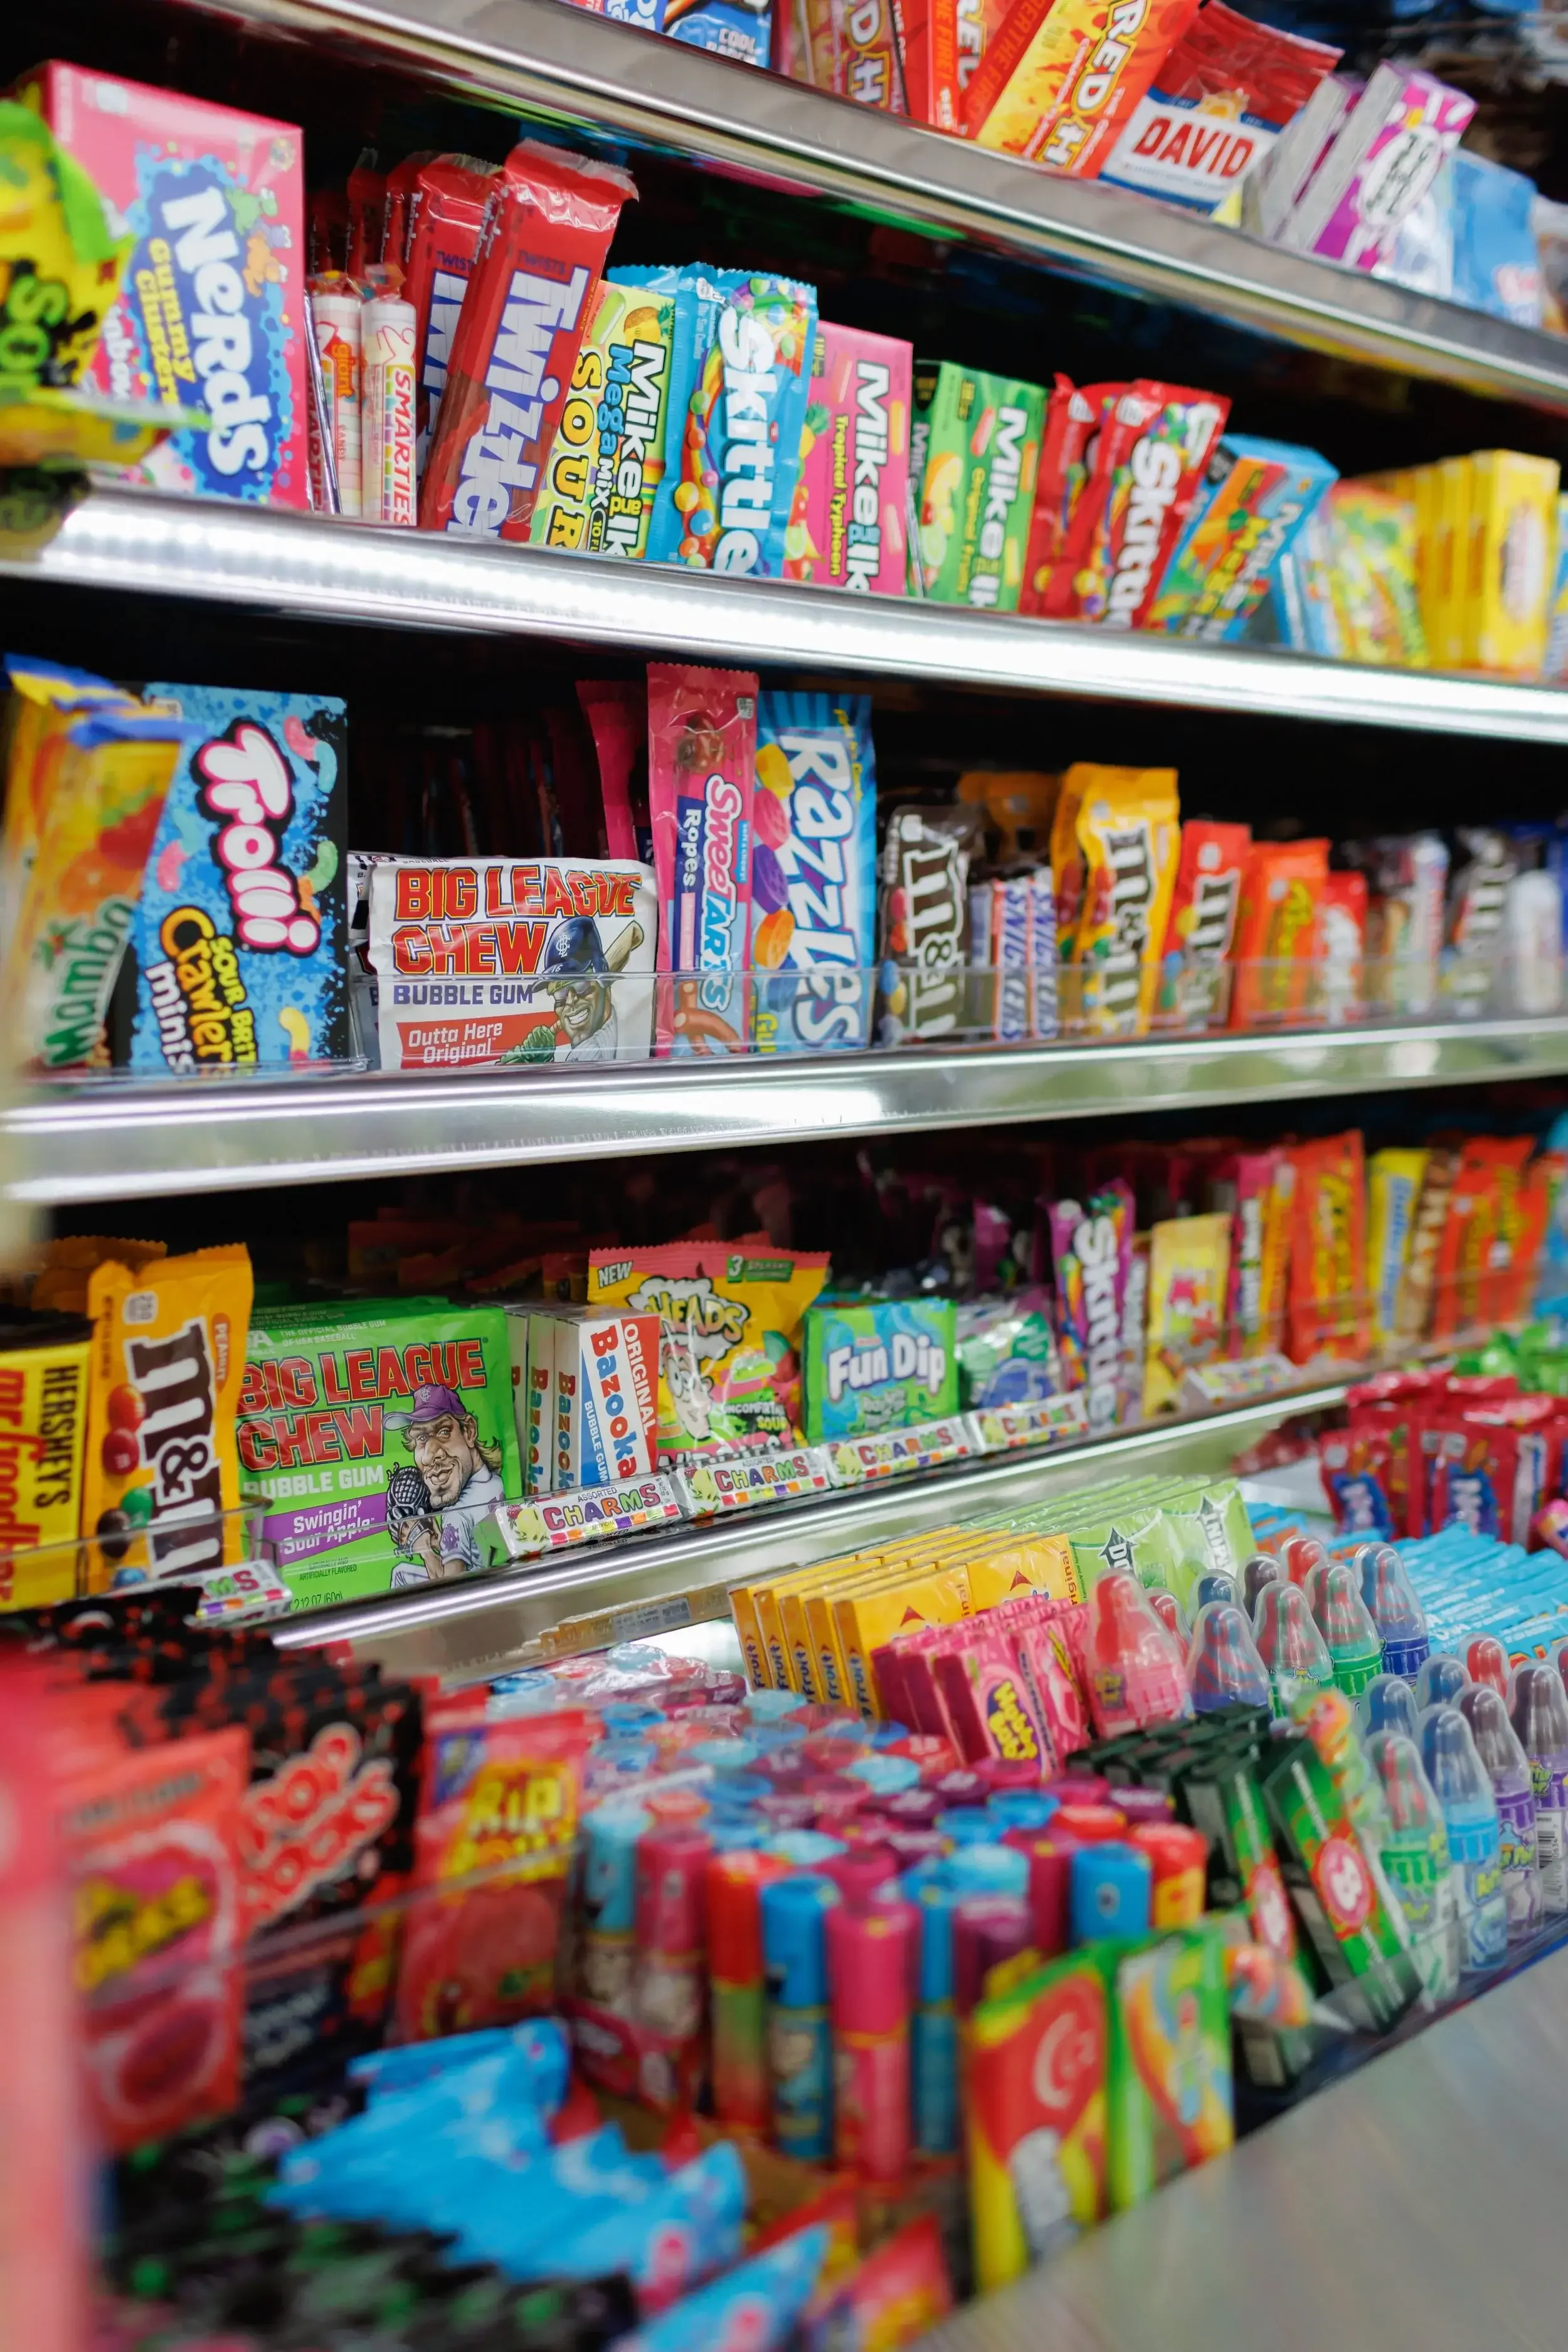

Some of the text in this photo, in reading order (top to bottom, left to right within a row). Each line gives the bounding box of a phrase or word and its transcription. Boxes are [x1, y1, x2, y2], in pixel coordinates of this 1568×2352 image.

[718, 28, 756, 54] COOL
[1132, 117, 1254, 177] DAVID
[596, 343, 634, 456] Mega
[617, 339, 667, 499] Mike
[393, 369, 412, 526] SMARTIES
[548, 351, 602, 549] SOUR
[852, 359, 889, 526] Mike
[829, 415, 849, 576] Tropical Typhoon
[980, 406, 1028, 559] Mike
[681, 808, 702, 888] Ropes
[394, 864, 642, 921] BIG LEAGUE
[209, 936, 247, 1005] SOUR
[391, 921, 550, 975] CHEW
[393, 985, 484, 1005] BUBBLE
[490, 983, 533, 1005] GUM
[408, 1022, 502, 1048] Outta Here
[598, 1261, 633, 1288] NEW
[729, 1255, 744, 1278] 3
[214, 1322, 228, 1381] PEANUT
[296, 1337, 314, 1345] USA
[315, 1333, 356, 1344] BASEBALL
[297, 1327, 336, 1335] OFFICIAL
[337, 1323, 368, 1331] BUBBLE
[236, 1357, 319, 1417] BIG
[318, 1337, 487, 1404] LEAGUE
[623, 1323, 656, 1436] ORIGINAL
[829, 1333, 946, 1404] Fun Dip
[590, 1324, 638, 1478] Bazooka
[236, 1402, 385, 1472] CHEW
[558, 1371, 576, 1489] Bazook
[584, 1400, 609, 1481] BUBBLE GUM
[858, 1426, 953, 1466] CHARMS
[244, 1465, 384, 1499] BUBBLE GUM
[714, 1455, 810, 1492] CHARMS
[742, 1456, 775, 1468] ASSORTED
[294, 1500, 362, 1534] Swingin'
[542, 1482, 661, 1532] CHARMS
[578, 1486, 618, 1503] ASSORTED
[283, 1532, 322, 1555] Sour
[591, 1520, 615, 1531] ARTIFICIAL
[299, 1564, 358, 1581] ARTIFICIALLY FLAVORED
[1059, 1550, 1079, 1606] riginal
[746, 1643, 766, 1688] Fruit
[795, 1650, 815, 1695] Fruit
[821, 1654, 842, 1700] Fruit
